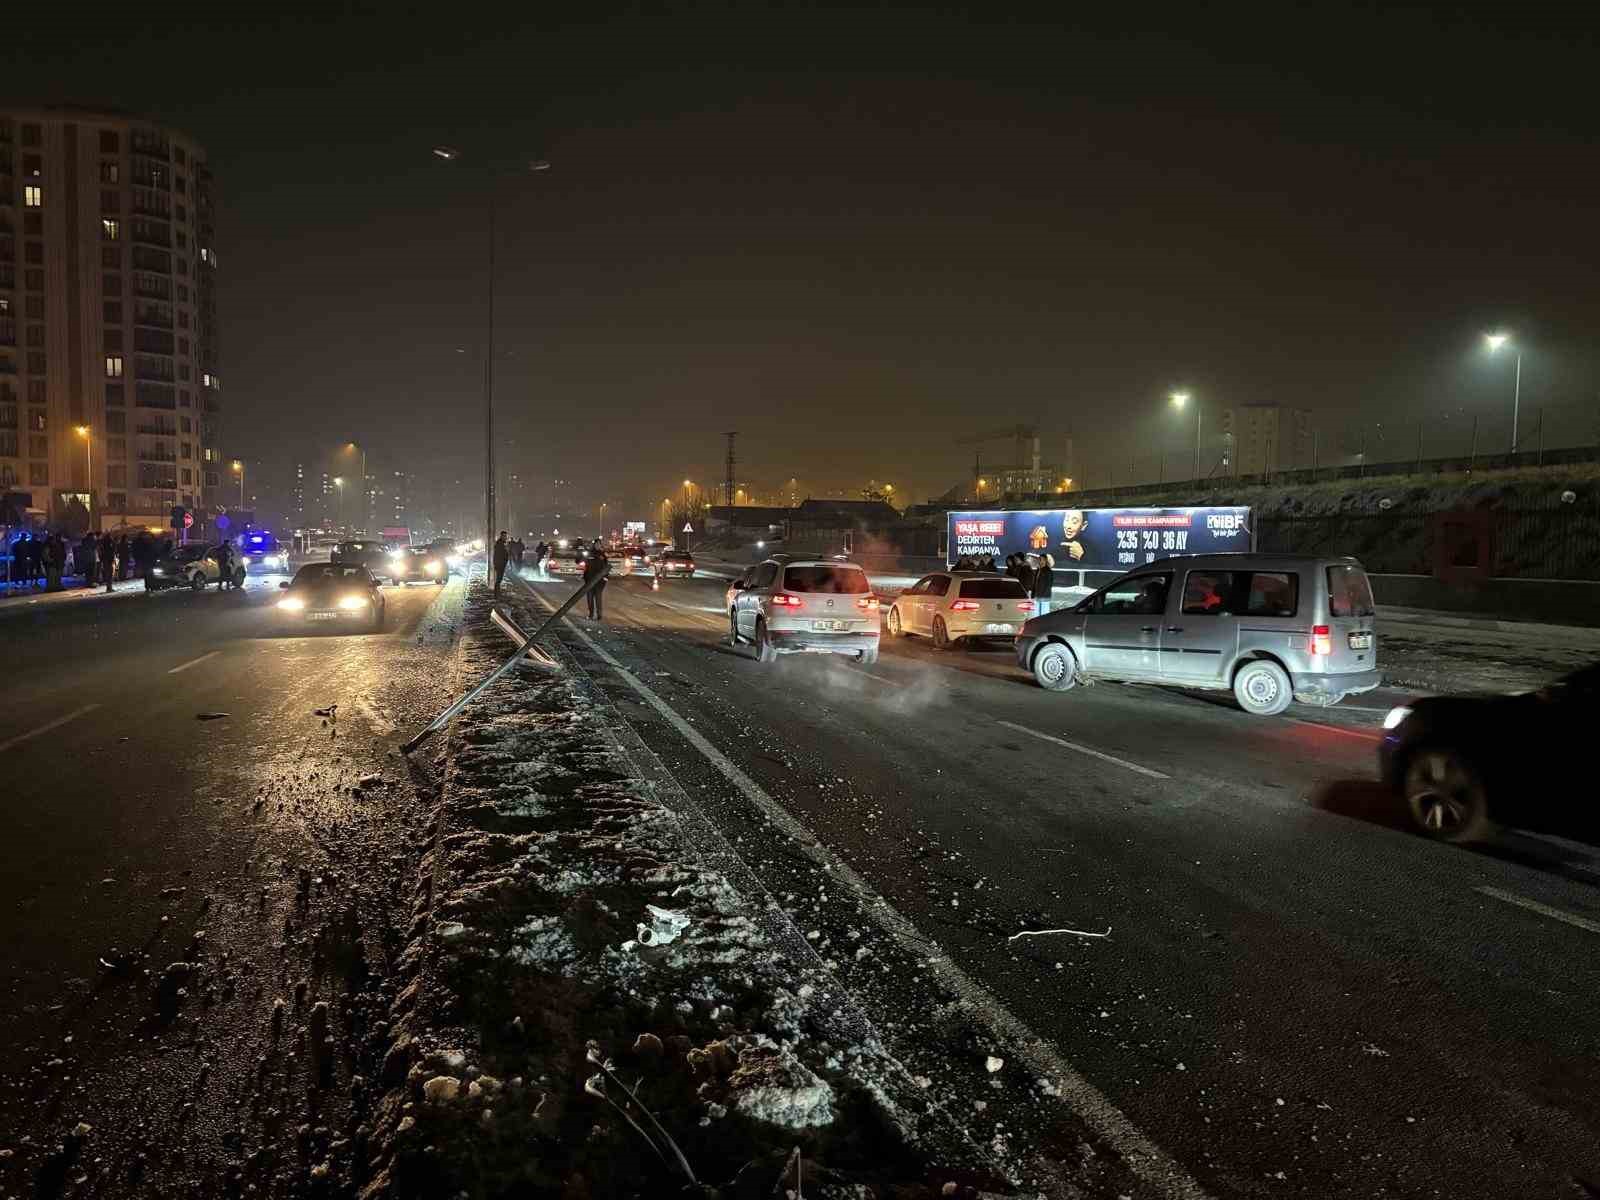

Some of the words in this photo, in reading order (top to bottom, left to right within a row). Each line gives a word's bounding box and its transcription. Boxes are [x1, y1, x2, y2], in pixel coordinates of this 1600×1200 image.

[957, 534, 995, 545] DEDİRTEN
[1117, 530, 1138, 549] %35
[1142, 530, 1159, 550] %0
[1162, 530, 1175, 550] 36
[1175, 530, 1188, 550] AY
[957, 545, 1001, 556] KAMPANYA
